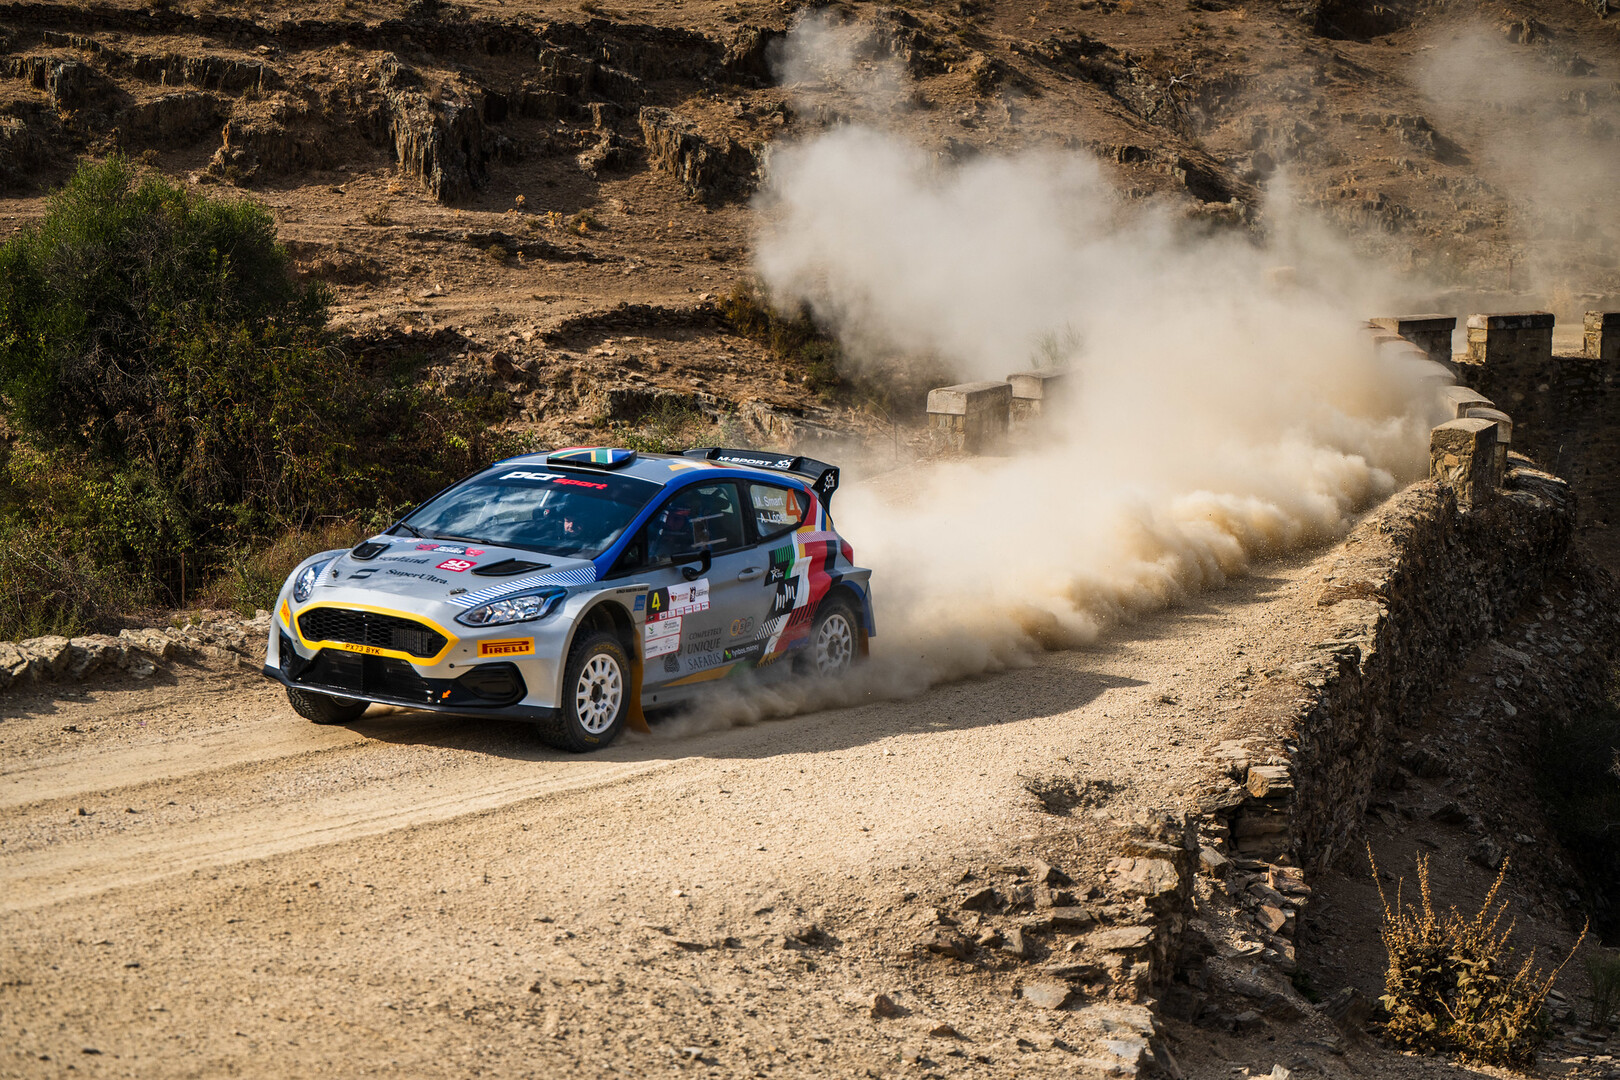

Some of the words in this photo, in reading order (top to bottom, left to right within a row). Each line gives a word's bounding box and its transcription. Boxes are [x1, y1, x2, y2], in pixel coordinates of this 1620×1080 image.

[717, 456, 773, 466] M-SPORT
[552, 478, 608, 490] sport
[764, 496, 784, 507] Smart
[786, 488, 802, 522] 4
[447, 560, 471, 569] sb
[385, 568, 448, 585] SuperUltra
[651, 591, 661, 611] 4
[688, 626, 722, 640] COMPLETELY
[345, 643, 364, 652] PX73
[365, 646, 380, 655] BYK
[482, 641, 530, 654] PIRELLI
[687, 637, 721, 654] UNIQUE
[688, 652, 722, 670] SAFARIS
